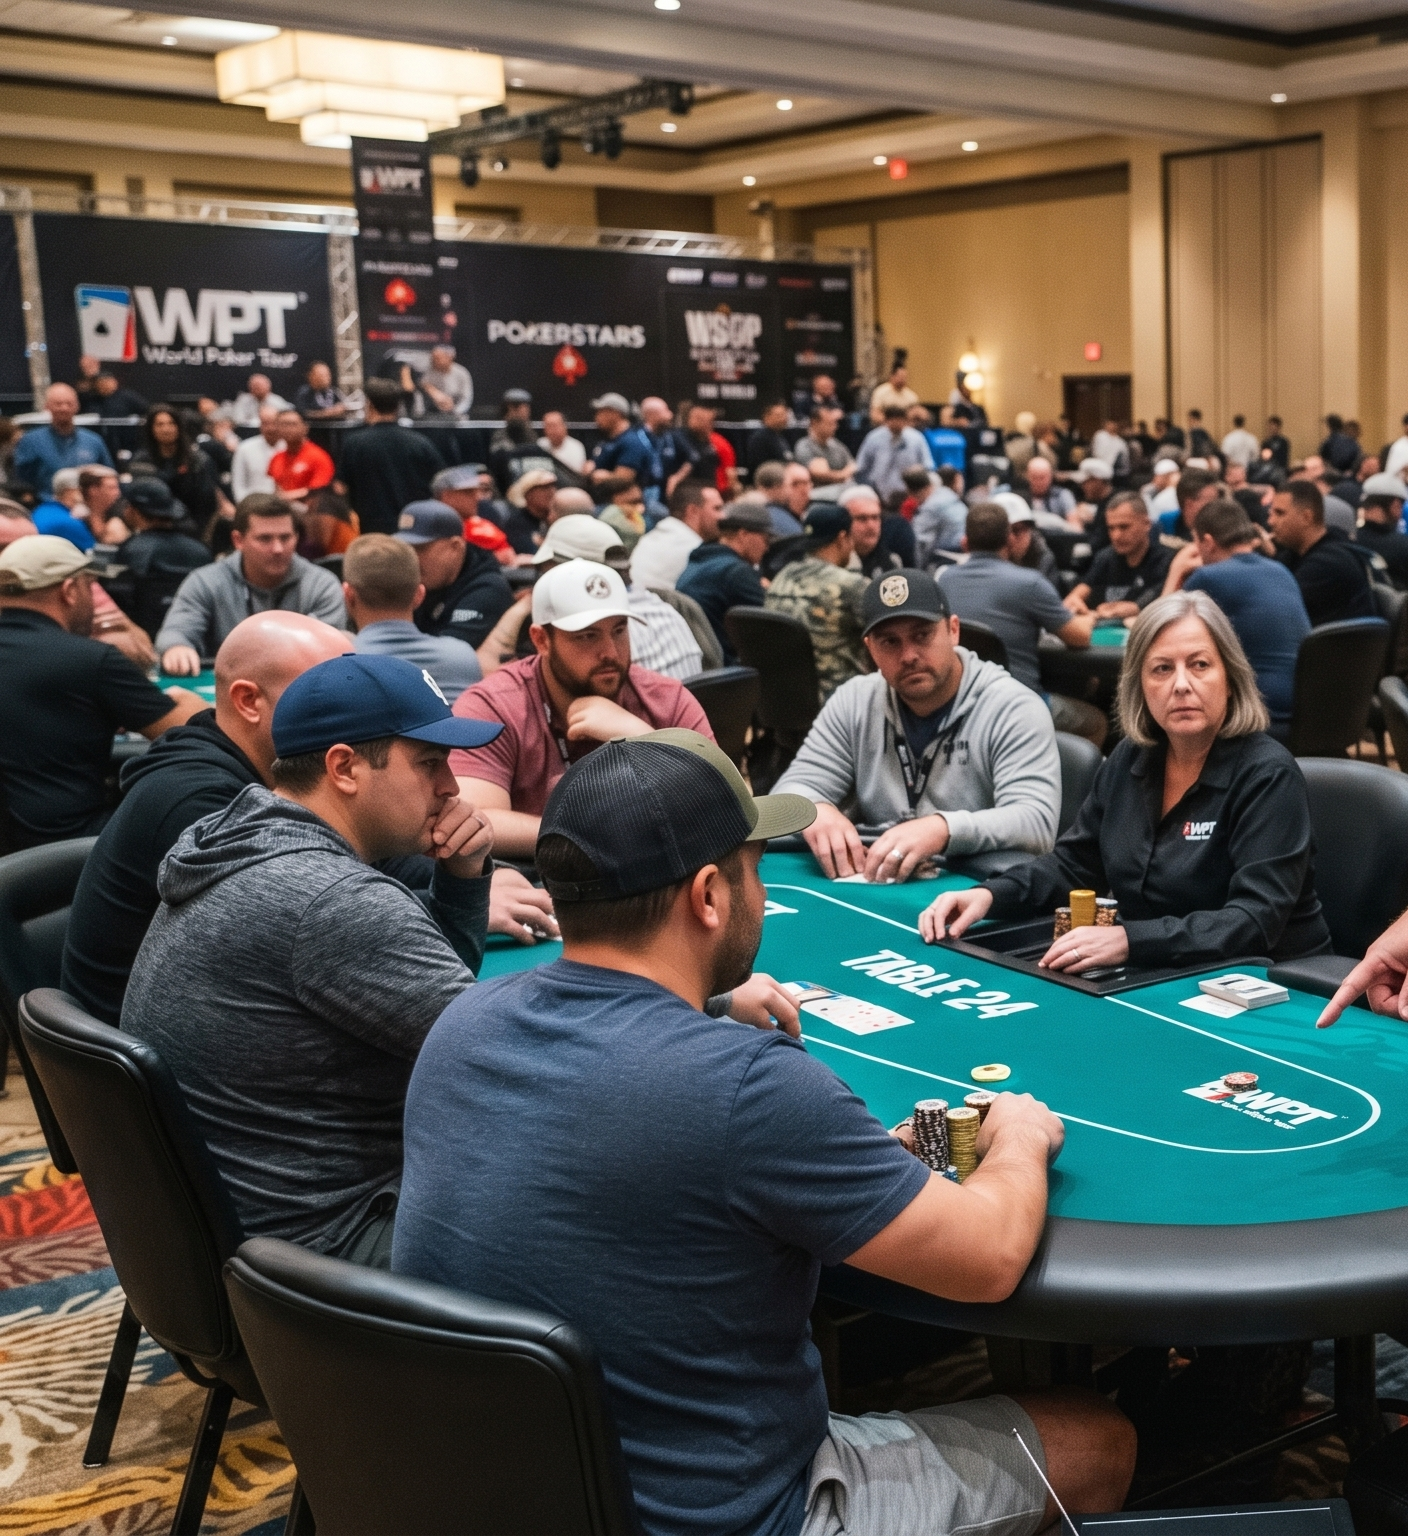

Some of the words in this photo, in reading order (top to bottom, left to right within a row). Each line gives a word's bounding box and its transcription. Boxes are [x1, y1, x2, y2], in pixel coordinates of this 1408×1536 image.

[133, 286, 299, 349] WPT
[487, 319, 647, 349] POKERSTARS
[1190, 821, 1217, 836] WPT
[840, 949, 981, 998] TABLE
[941, 990, 1039, 1019] 24
